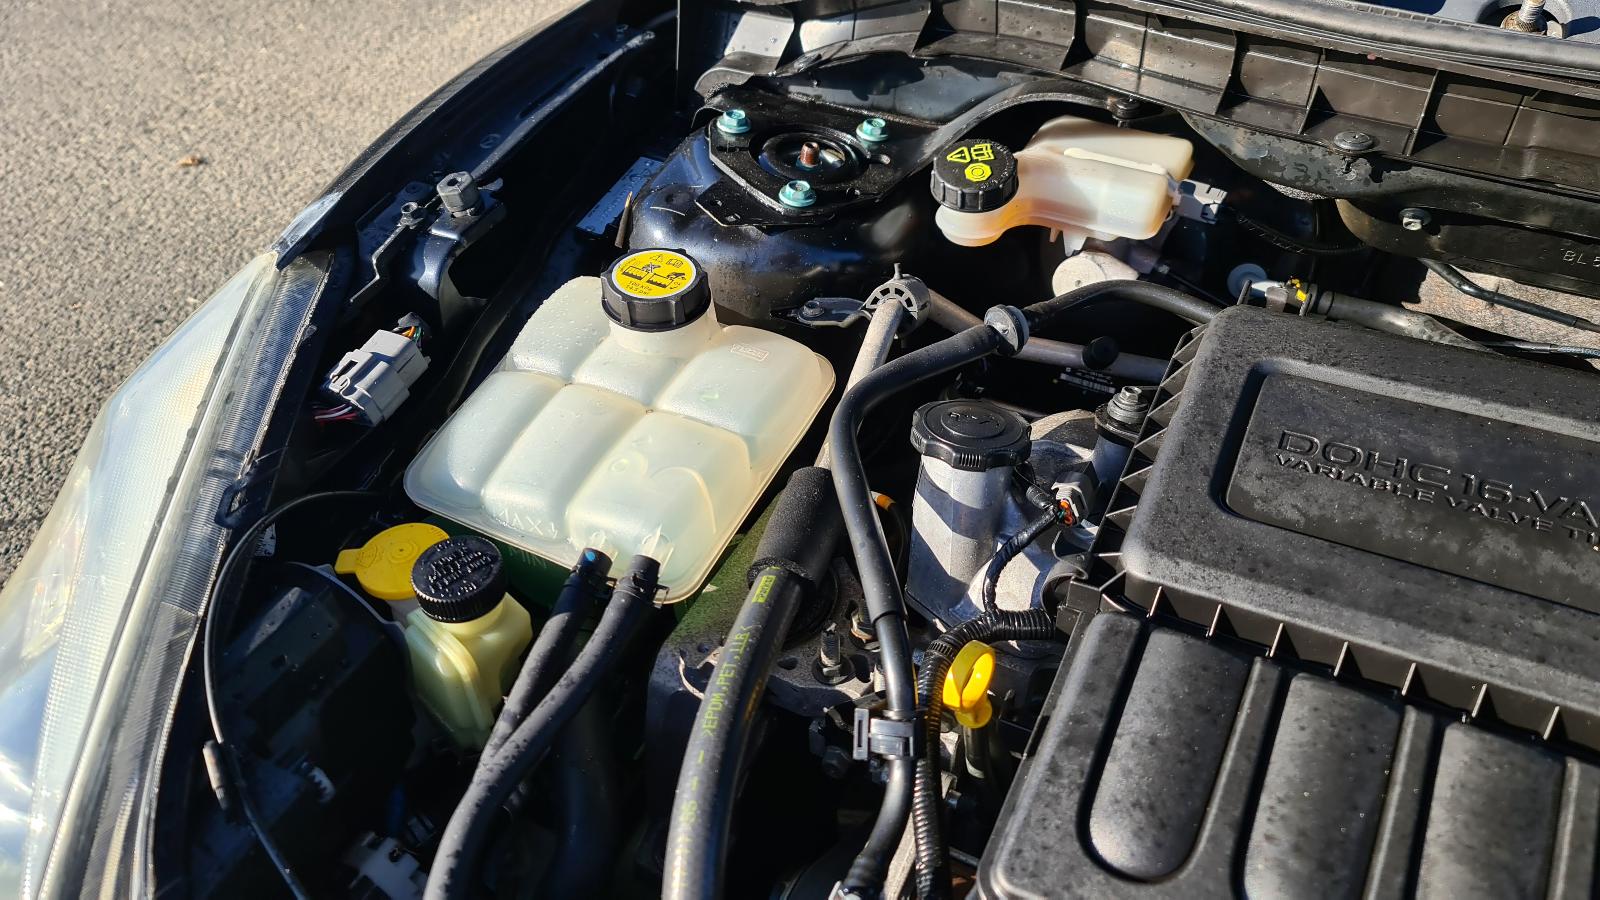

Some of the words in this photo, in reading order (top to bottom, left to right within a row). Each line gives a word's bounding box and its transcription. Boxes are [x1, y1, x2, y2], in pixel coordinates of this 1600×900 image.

[1277, 429, 1451, 490] DOHC
[1274, 452, 1438, 503] VARIABLE
[1446, 495, 1554, 532] VALVE
[1562, 524, 1600, 546] TI
